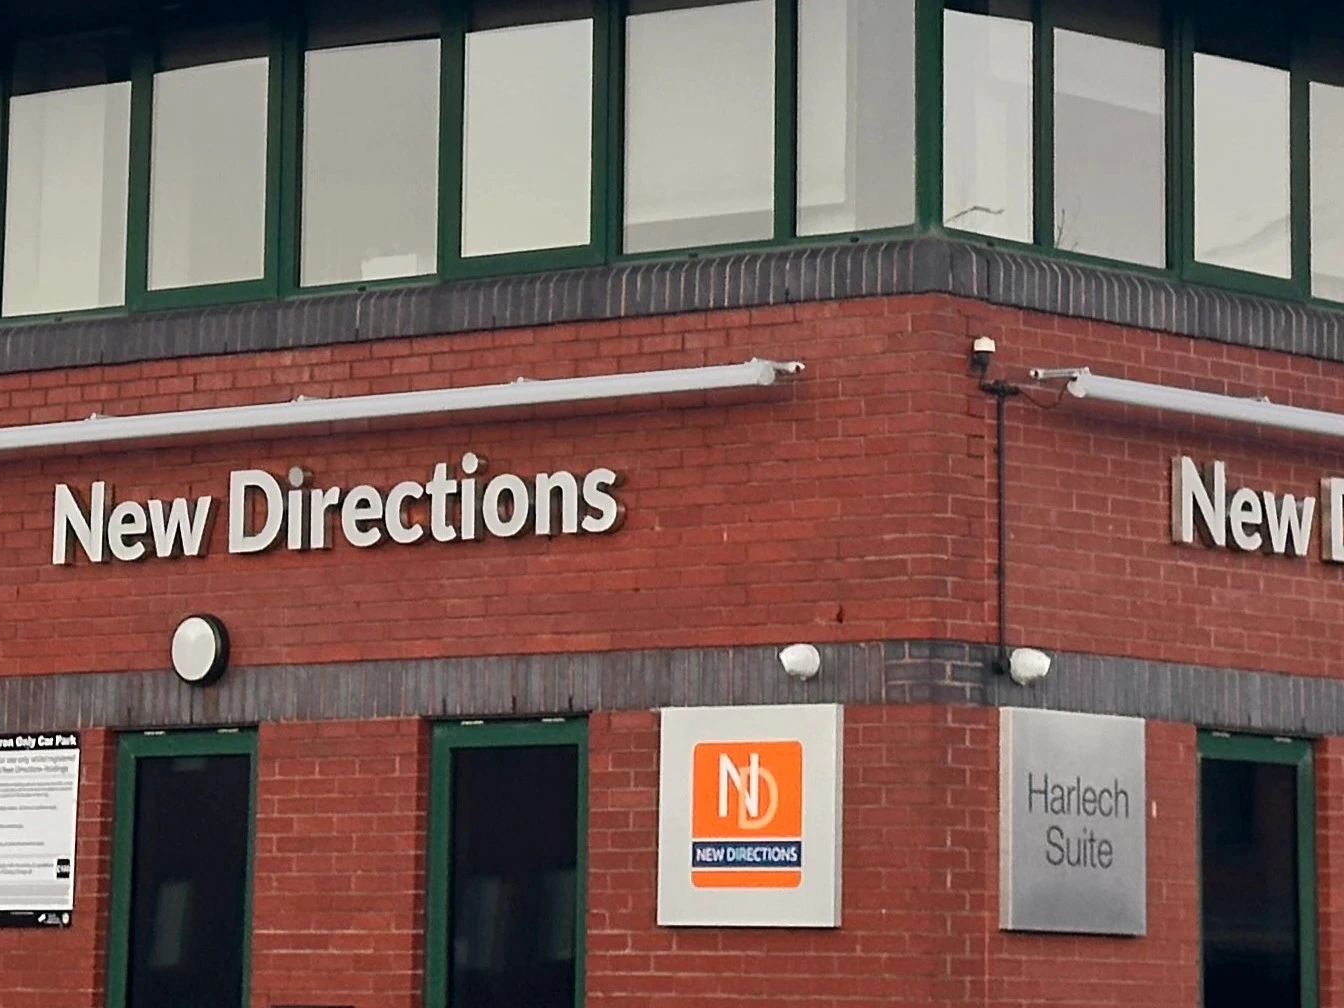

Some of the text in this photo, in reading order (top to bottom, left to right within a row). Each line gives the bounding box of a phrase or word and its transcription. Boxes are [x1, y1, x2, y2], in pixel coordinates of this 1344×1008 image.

[53, 452, 622, 566] New Directions
[1173, 455, 1316, 556] New
[16, 735, 36, 749] Only
[37, 734, 54, 747] Car
[55, 734, 77, 746] Park
[1028, 772, 1130, 820] Harlech
[695, 845, 798, 863] NEW DIRECTIONS
[1044, 824, 1114, 870] Suite
